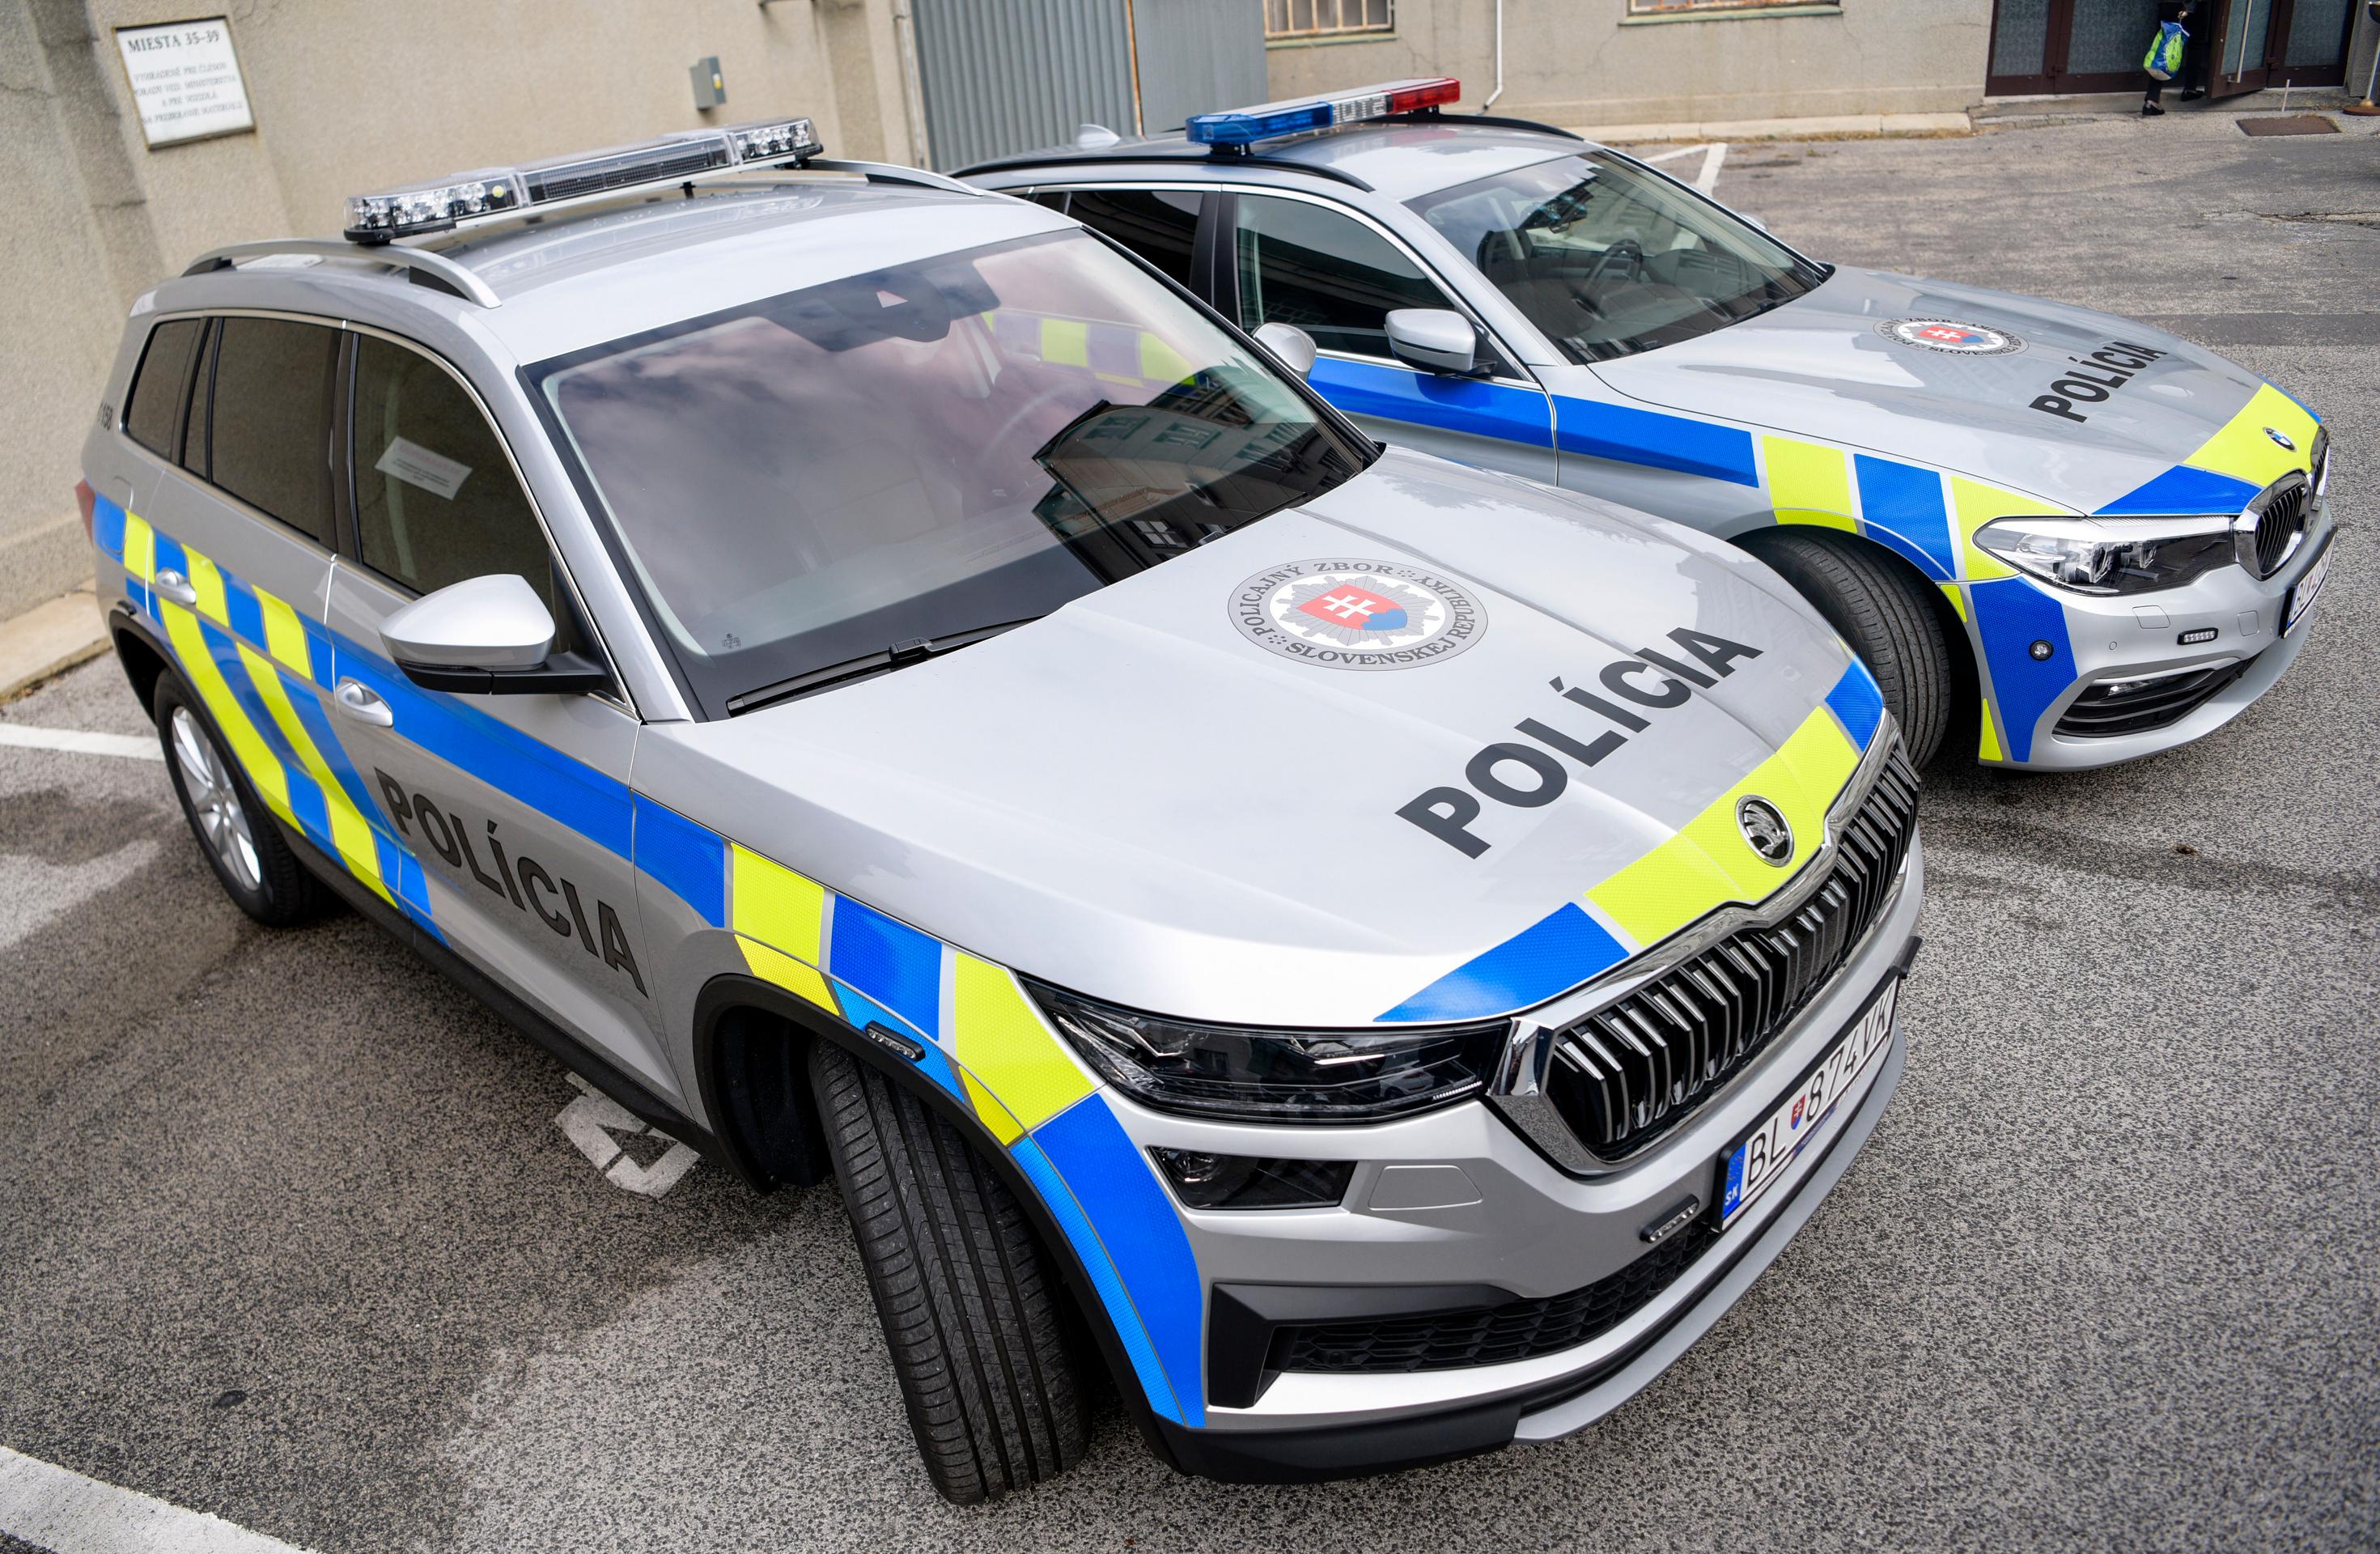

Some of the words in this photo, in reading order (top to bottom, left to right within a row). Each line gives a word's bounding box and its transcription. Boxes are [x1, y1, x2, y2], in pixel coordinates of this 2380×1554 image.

[128, 34, 181, 53] MIESTA
[2029, 341, 2169, 423] POLÍCIA
[1239, 564, 1305, 637] POLICAJNÝ
[1313, 562, 1394, 575] ZBOR
[1285, 636, 1457, 665] SLOVENSKEJ
[1411, 575, 1476, 640] REPUBLIKY
[1394, 626, 1764, 860] POLÍCIA
[374, 766, 649, 1000] POLÍCIA
[1747, 1116, 1786, 1188] BL
[1725, 1183, 1739, 1206] SK
